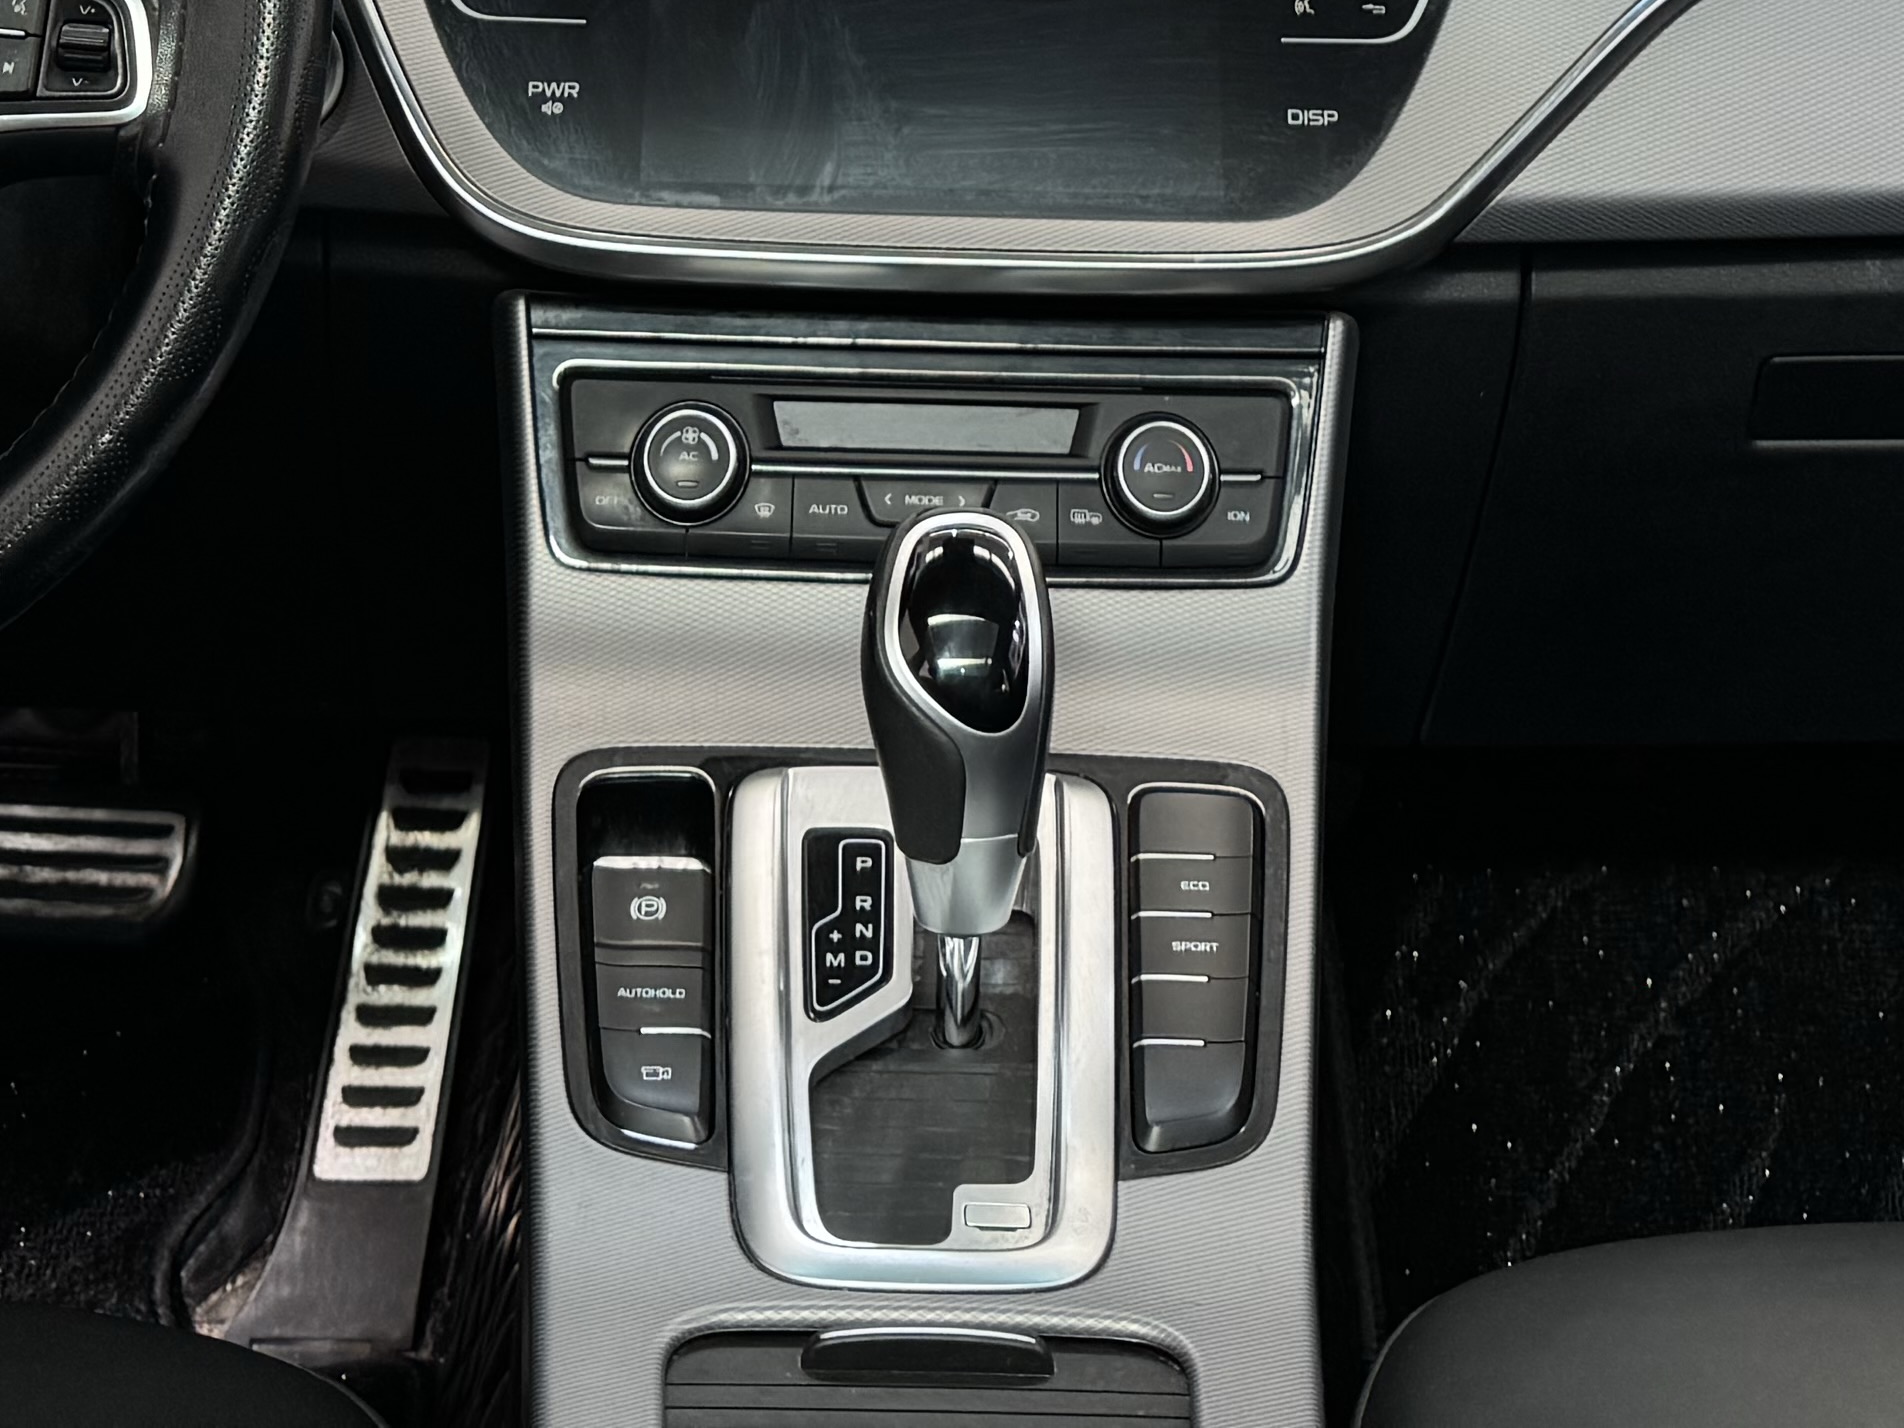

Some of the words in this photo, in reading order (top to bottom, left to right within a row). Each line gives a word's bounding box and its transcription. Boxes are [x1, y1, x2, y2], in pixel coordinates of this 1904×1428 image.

[527, 80, 581, 98] PWR
[1287, 108, 1339, 126] DISP
[678, 451, 699, 462] AC
[904, 495, 945, 506] MODE
[808, 504, 849, 516] AUTO
[1227, 510, 1251, 523] ION
[856, 856, 873, 872] P
[1180, 880, 1210, 891] ECO
[855, 895, 873, 911] R
[855, 923, 873, 938] N
[1171, 940, 1220, 953] SPORT
[825, 952, 845, 968] M
[855, 950, 873, 966] D
[616, 987, 686, 999] AUTOHOLD
